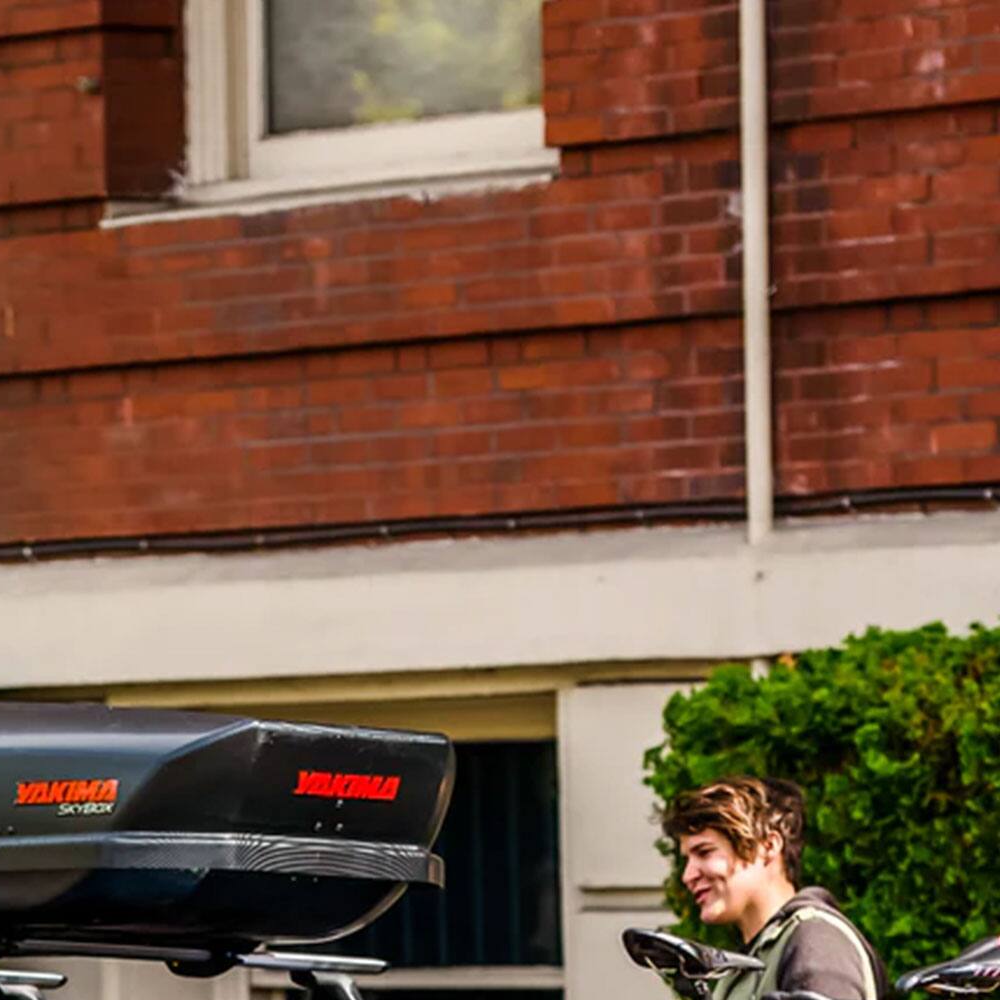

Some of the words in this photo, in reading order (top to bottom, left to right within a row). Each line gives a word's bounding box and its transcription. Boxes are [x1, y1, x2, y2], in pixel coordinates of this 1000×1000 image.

[14, 779, 118, 805] YAKIMA
[292, 770, 400, 800] YAKIMA
[57, 802, 115, 816] SKYBOX
